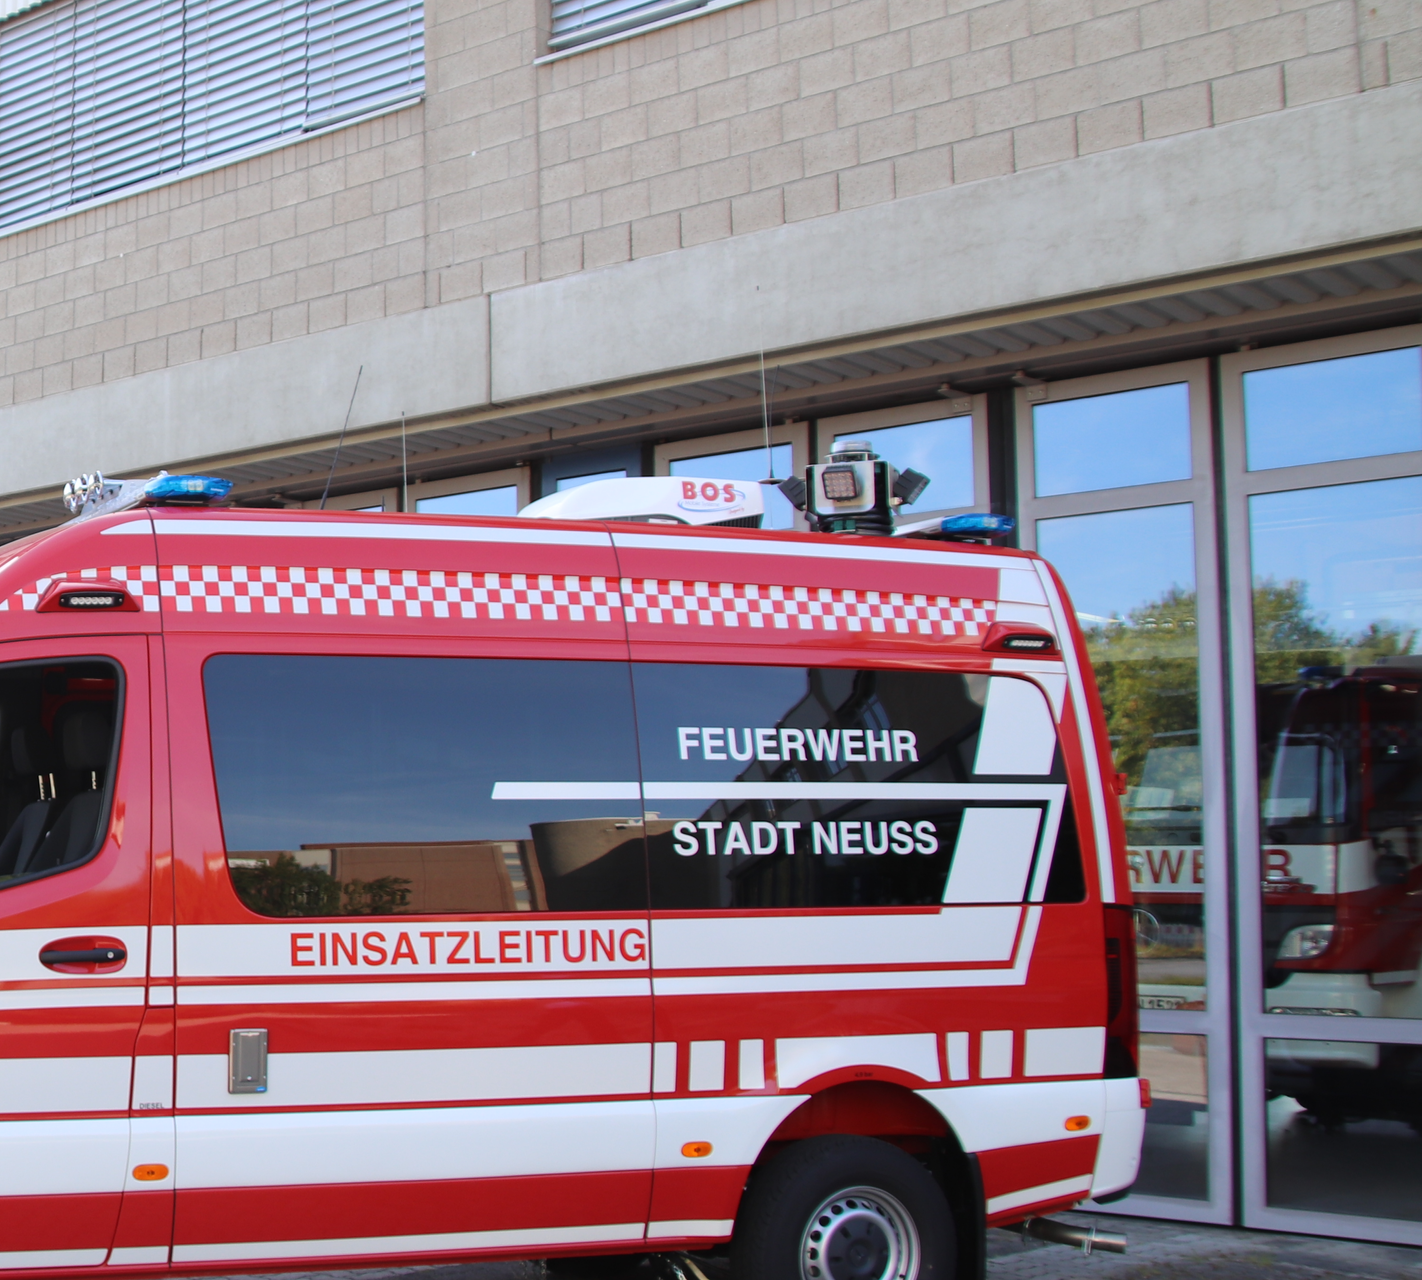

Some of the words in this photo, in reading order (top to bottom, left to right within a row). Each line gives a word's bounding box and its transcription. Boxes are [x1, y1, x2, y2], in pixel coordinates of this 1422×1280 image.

[682, 481, 736, 503] BOS
[677, 726, 920, 762] FEUERWEHR
[672, 820, 801, 857] STADT
[811, 820, 939, 856] NEUSS
[290, 927, 647, 967] EINSATZLEITUNG
